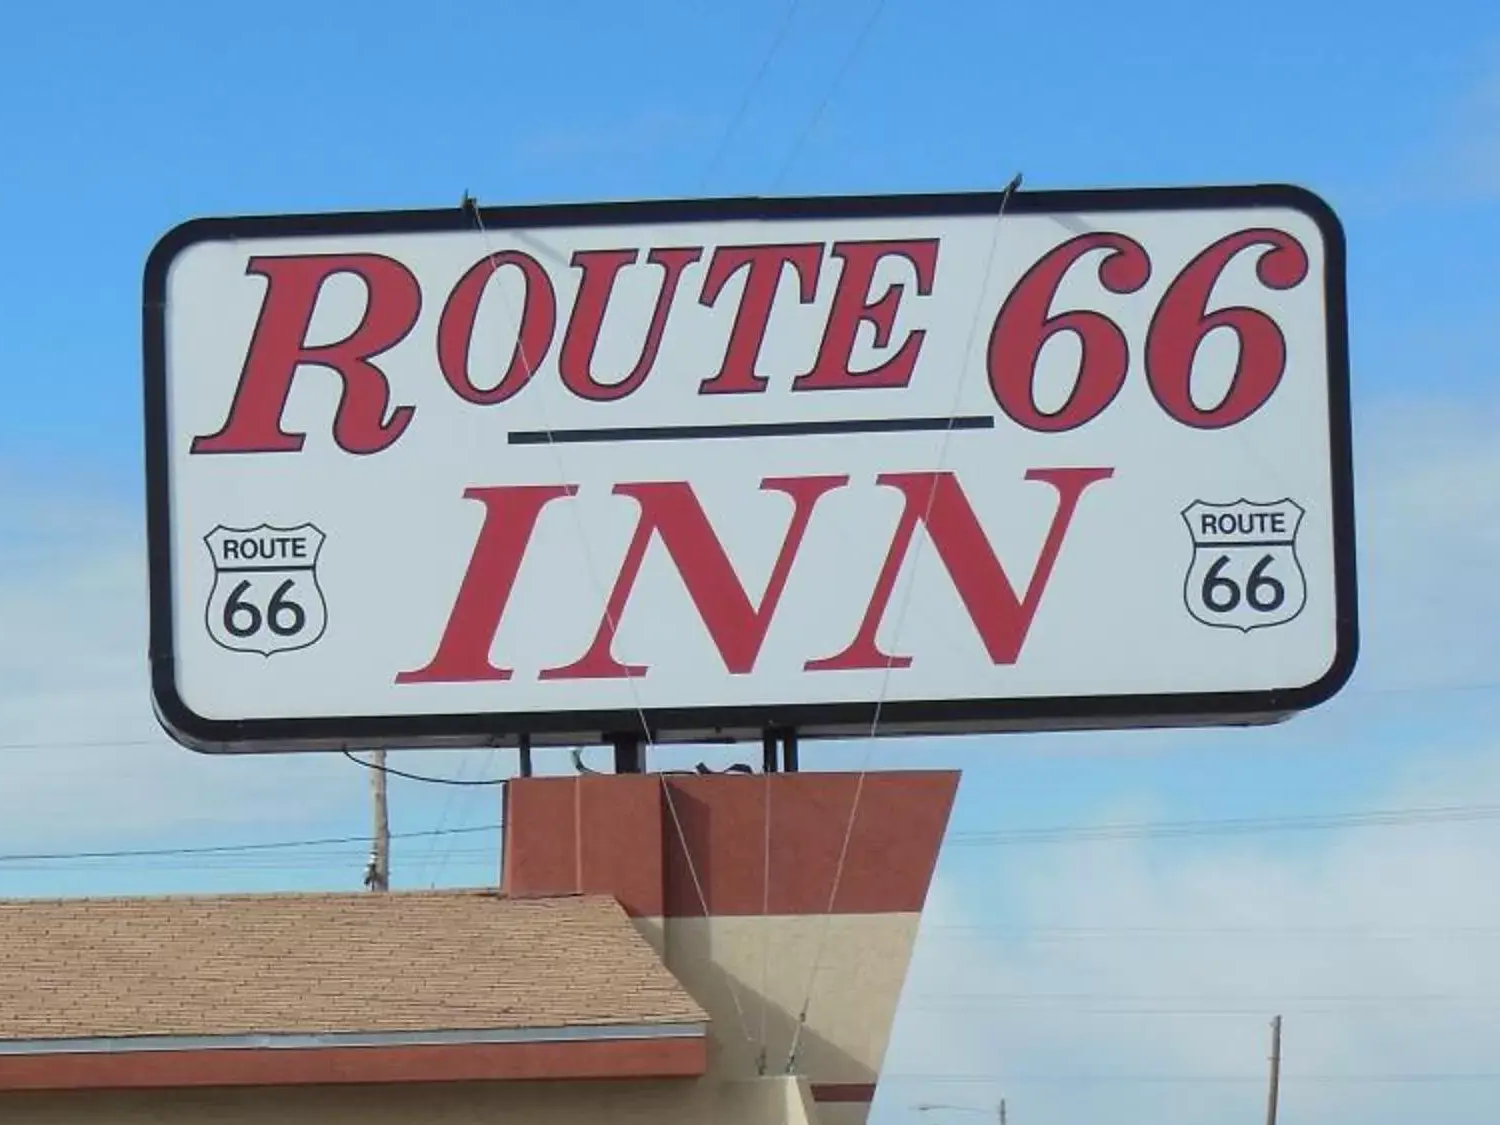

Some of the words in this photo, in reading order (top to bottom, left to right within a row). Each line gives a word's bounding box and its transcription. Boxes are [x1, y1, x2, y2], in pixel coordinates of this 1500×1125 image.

[190, 237, 940, 455] ROUTE
[987, 228, 1309, 432] 66
[224, 537, 307, 559] ROUTE
[1202, 512, 1285, 535] ROUTE
[395, 467, 1115, 683] INN
[1203, 554, 1285, 613] 66
[224, 579, 305, 637] 66
